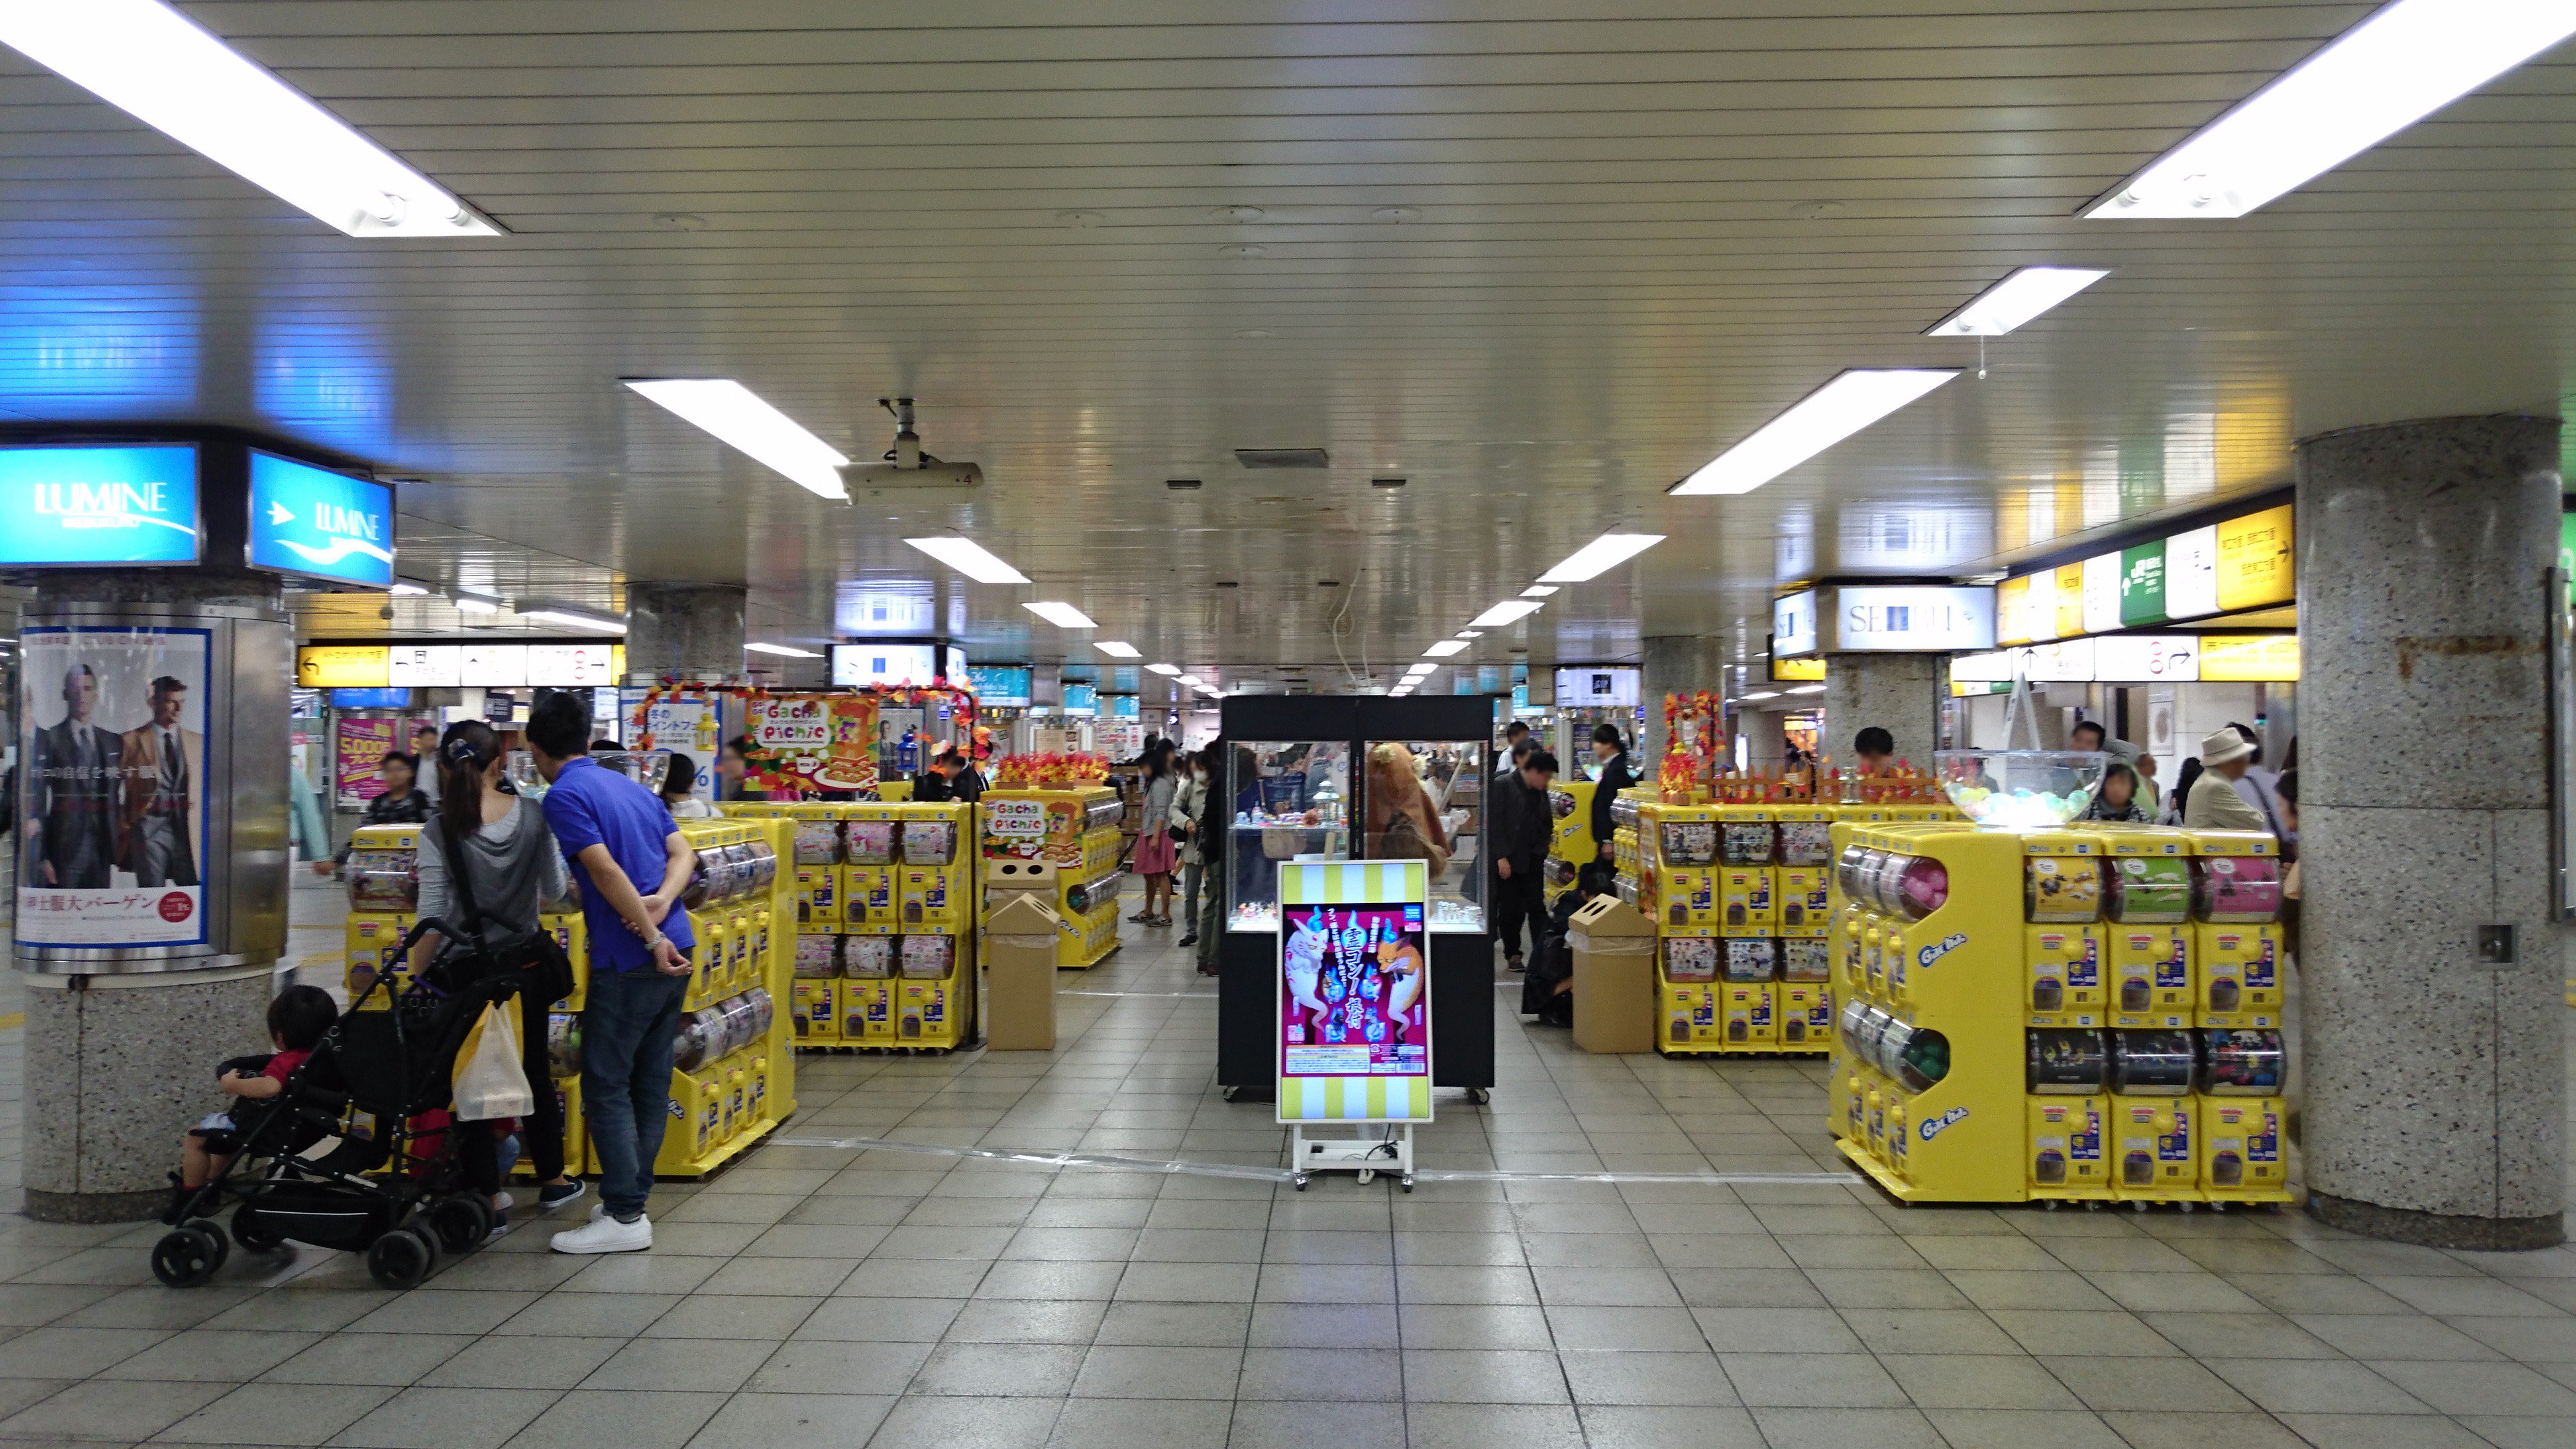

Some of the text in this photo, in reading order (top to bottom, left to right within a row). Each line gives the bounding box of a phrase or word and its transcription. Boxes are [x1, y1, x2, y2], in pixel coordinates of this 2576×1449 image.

[35, 482, 167, 514] LUMINE
[316, 502, 379, 541] LUMINE
[998, 804, 1039, 814] Gacha
